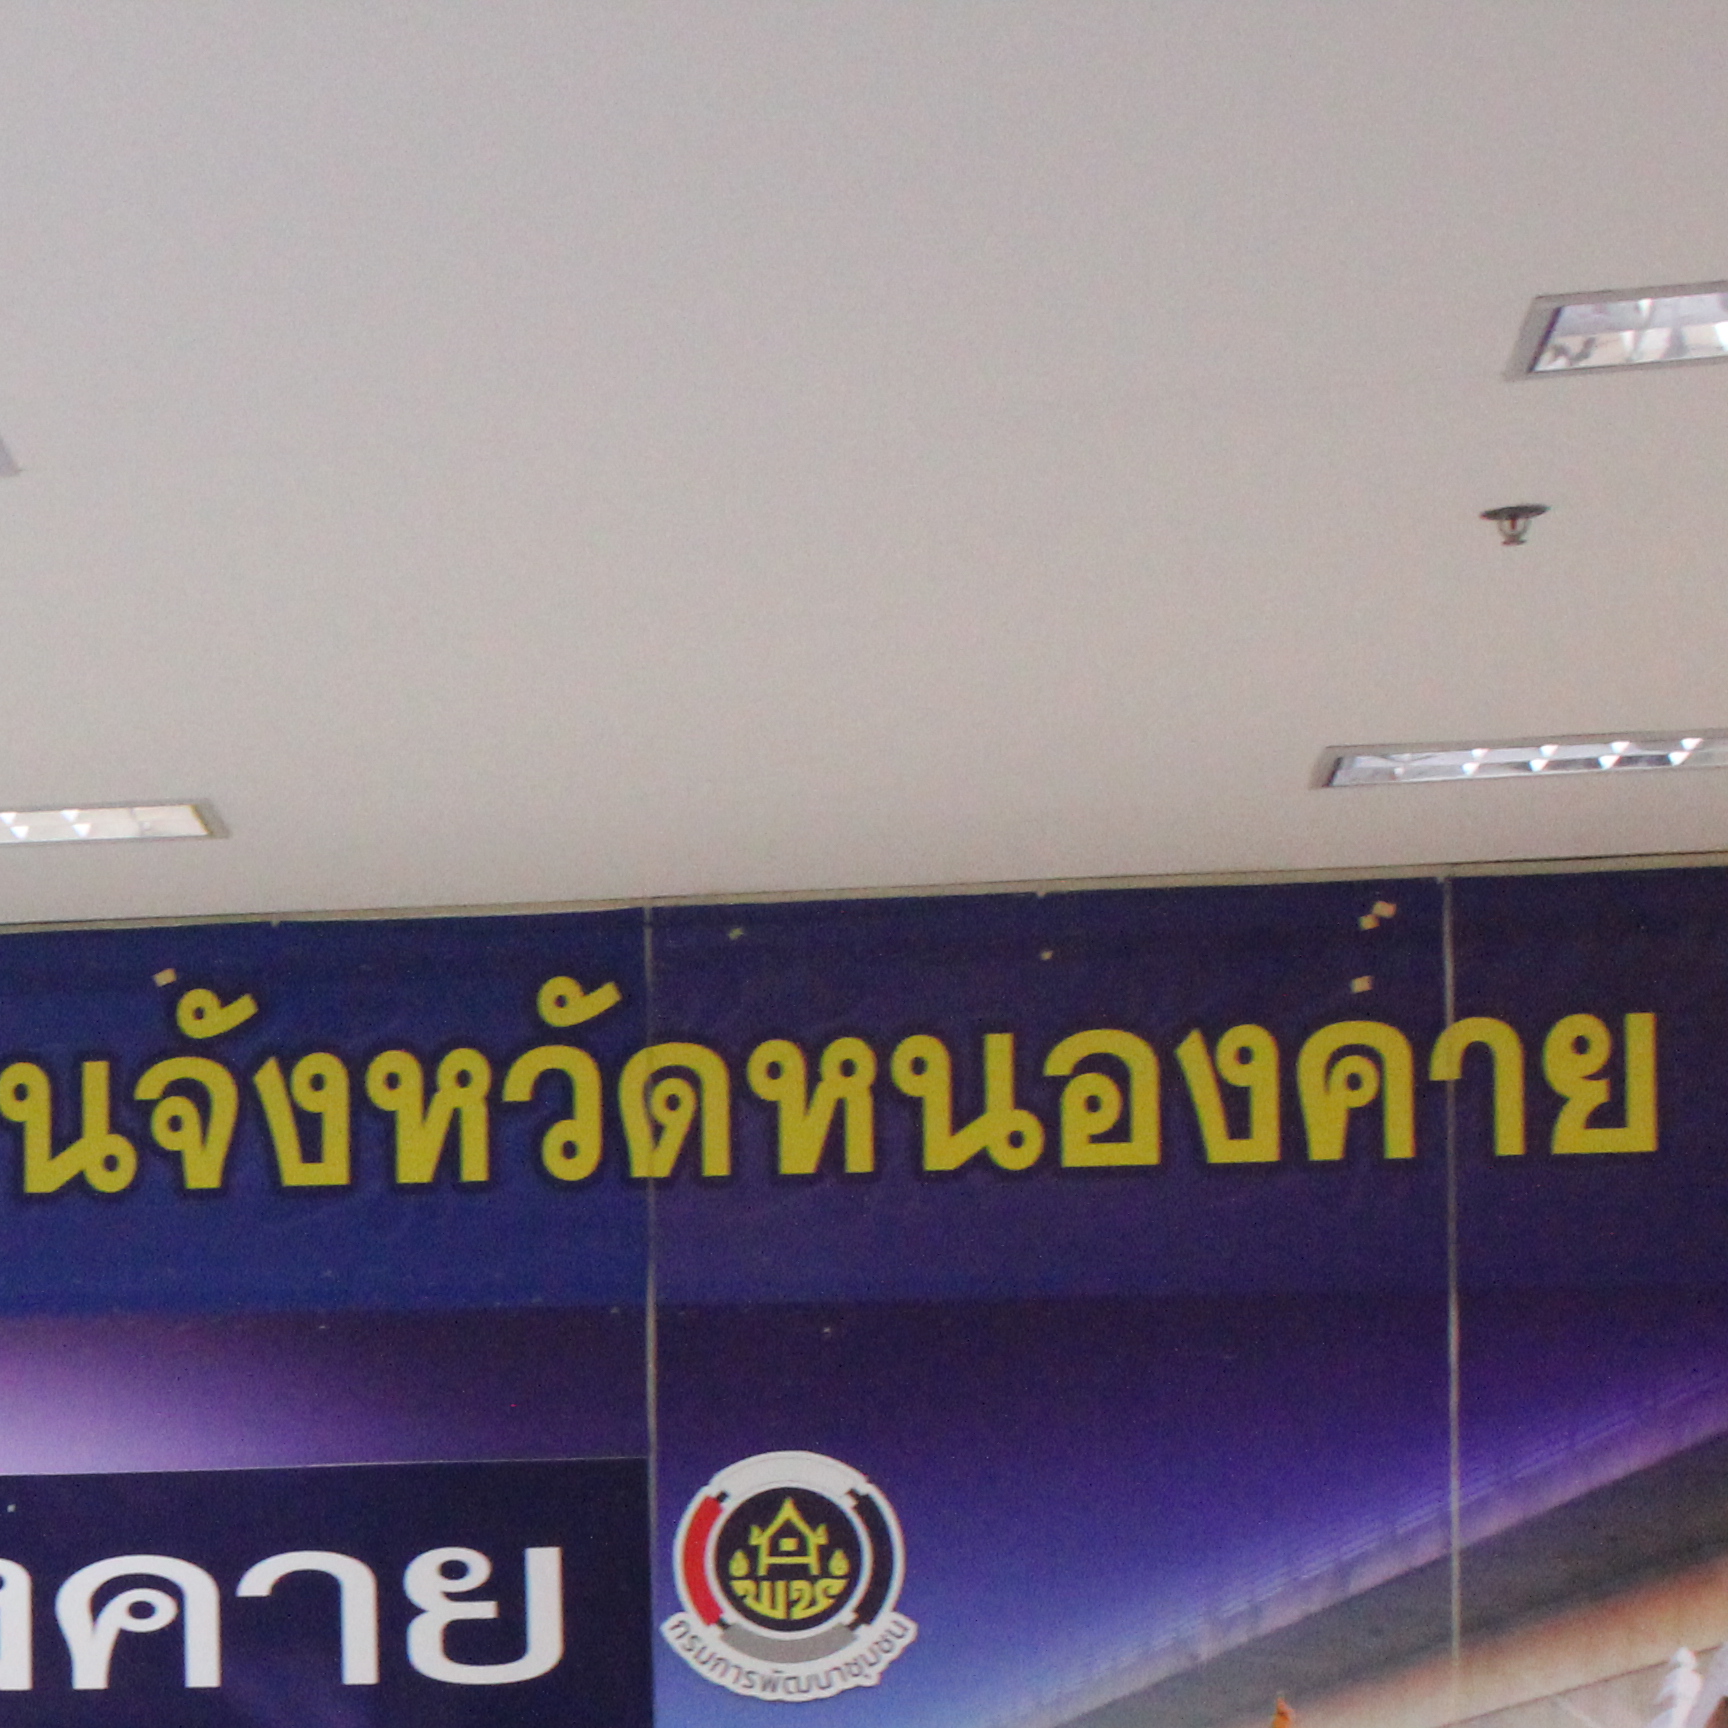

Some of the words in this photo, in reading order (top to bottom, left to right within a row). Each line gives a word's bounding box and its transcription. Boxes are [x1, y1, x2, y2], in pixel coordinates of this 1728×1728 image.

[668, 1619, 911, 1695] กรมการพัฒนาชุมชน
